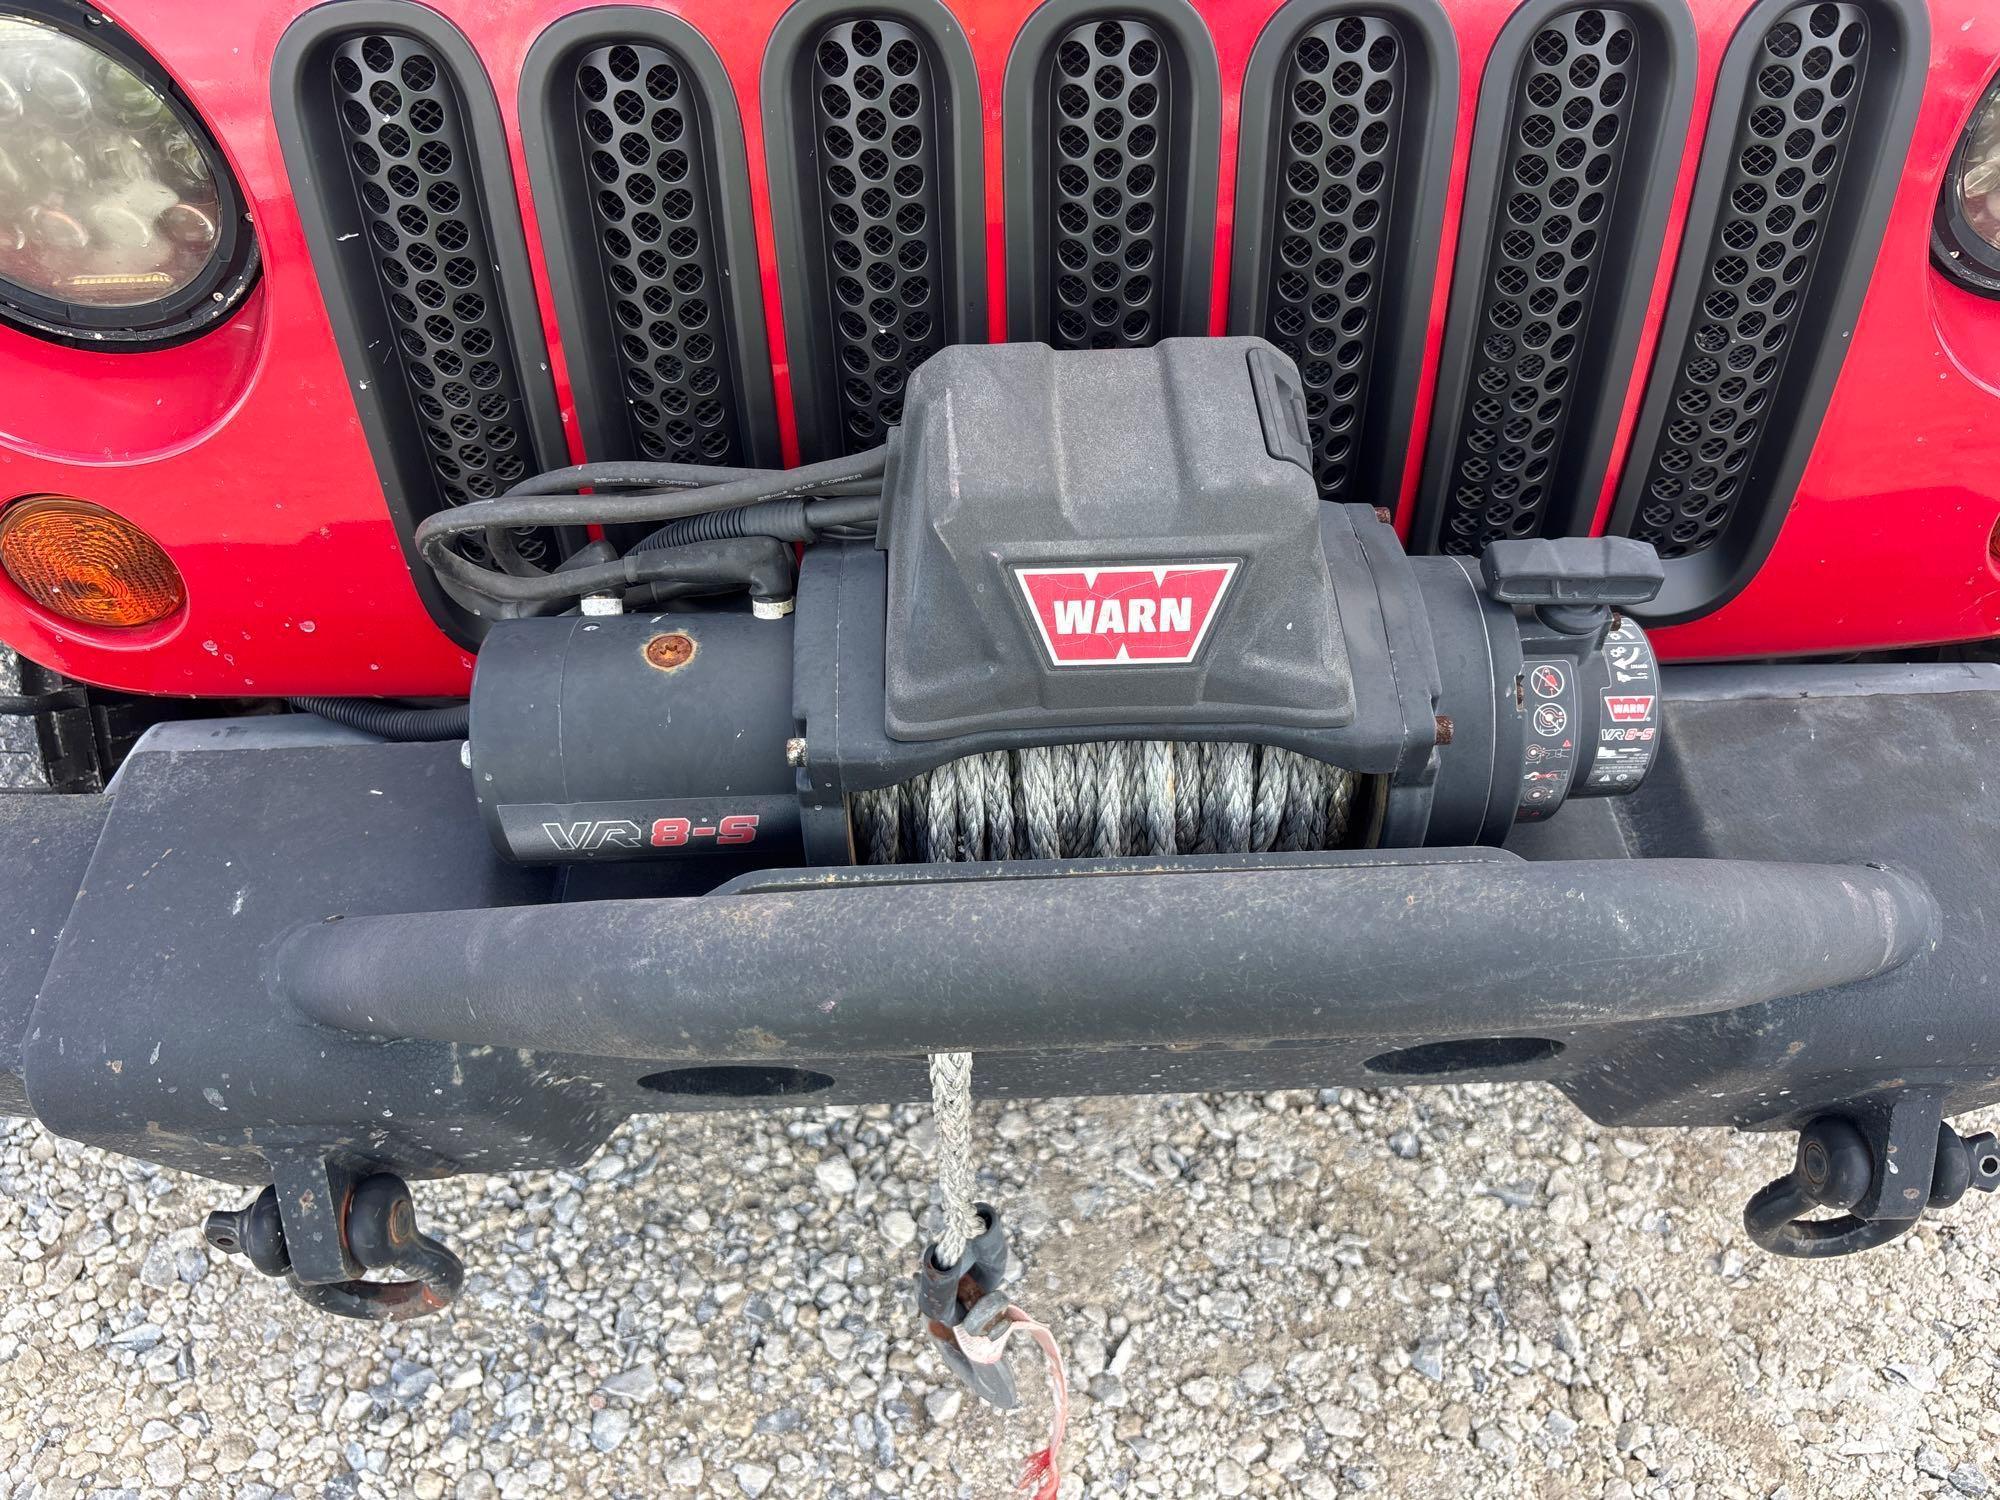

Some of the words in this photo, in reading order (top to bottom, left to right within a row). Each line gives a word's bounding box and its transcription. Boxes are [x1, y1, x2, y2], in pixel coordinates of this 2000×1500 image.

[657, 479, 699, 487] COPPER
[794, 483, 815, 491] SAE
[821, 473, 862, 486] COPPER
[1053, 597, 1192, 635] WARN
[1613, 704, 1645, 714] WARN
[1601, 729, 1625, 740] VR
[542, 820, 642, 850] VR
[650, 815, 759, 847] 8-S
